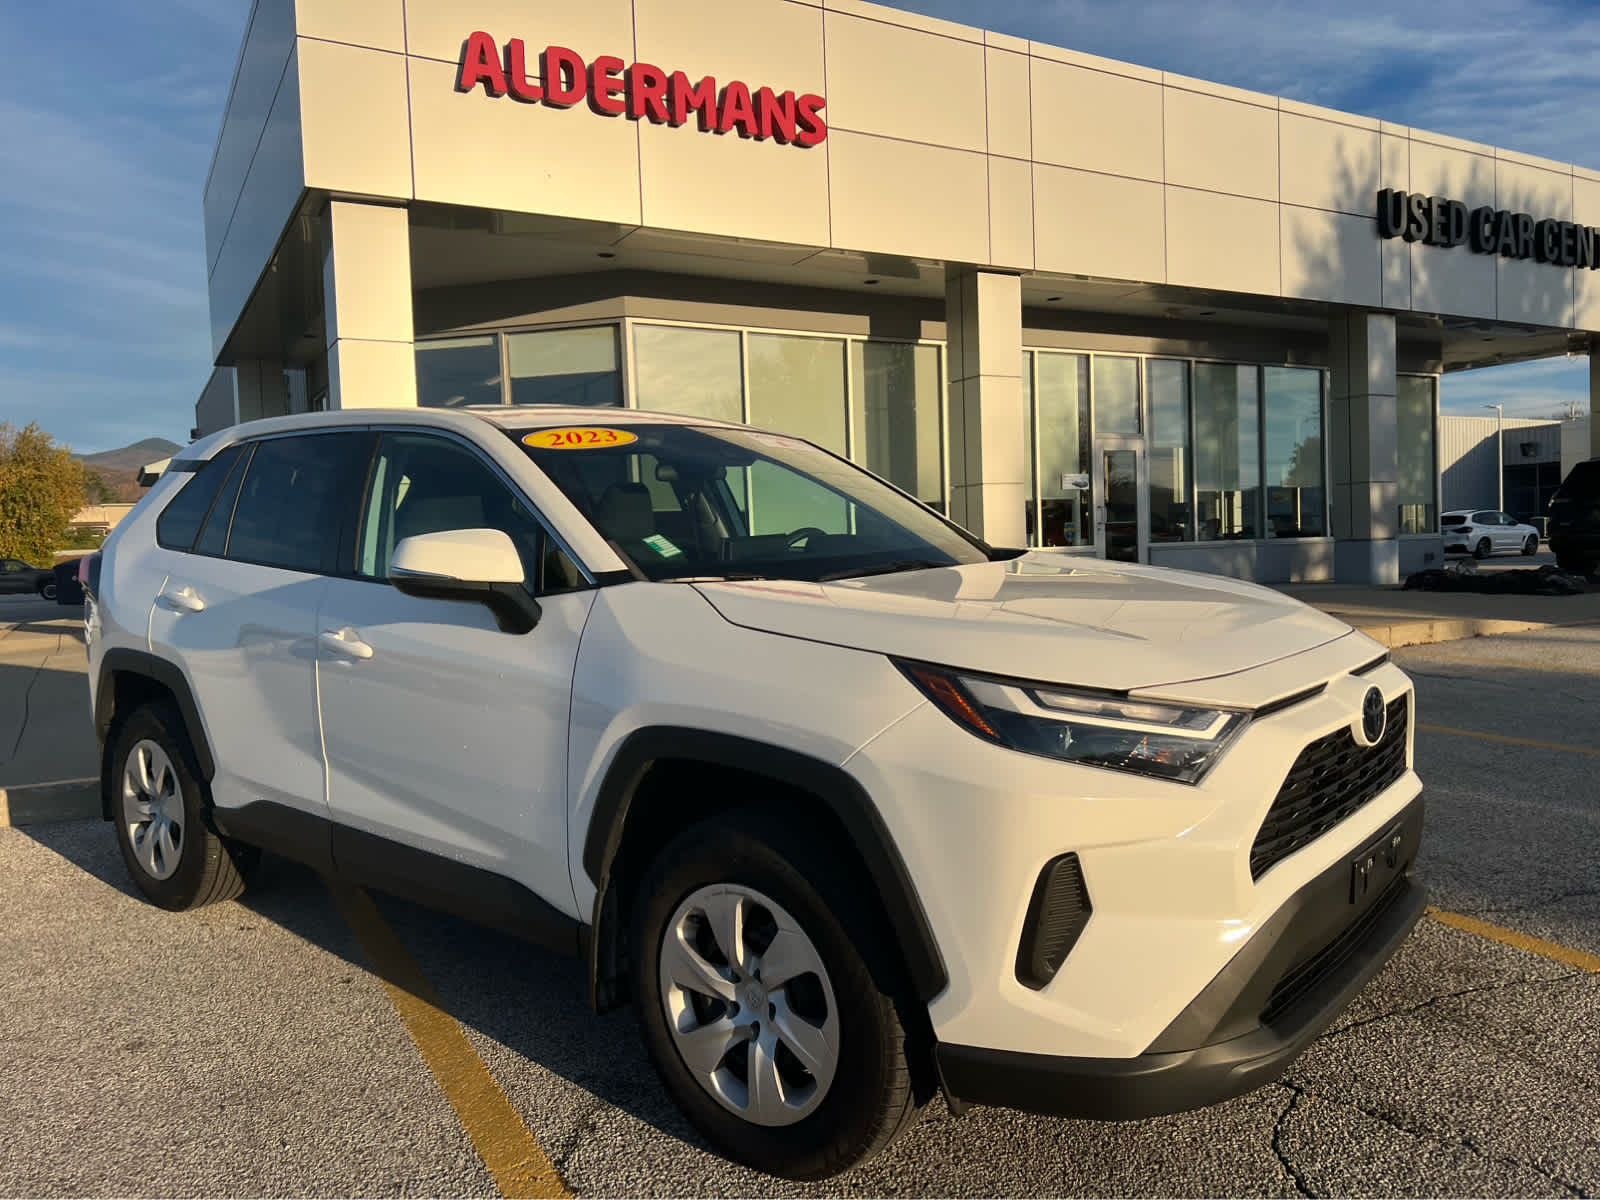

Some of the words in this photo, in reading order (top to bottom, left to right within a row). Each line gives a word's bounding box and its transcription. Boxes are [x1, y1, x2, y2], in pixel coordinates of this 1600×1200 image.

[455, 30, 828, 148] ALDERMANS
[1377, 188, 1468, 247] USED
[1471, 206, 1535, 259] CAR
[547, 430, 618, 447] 2023
